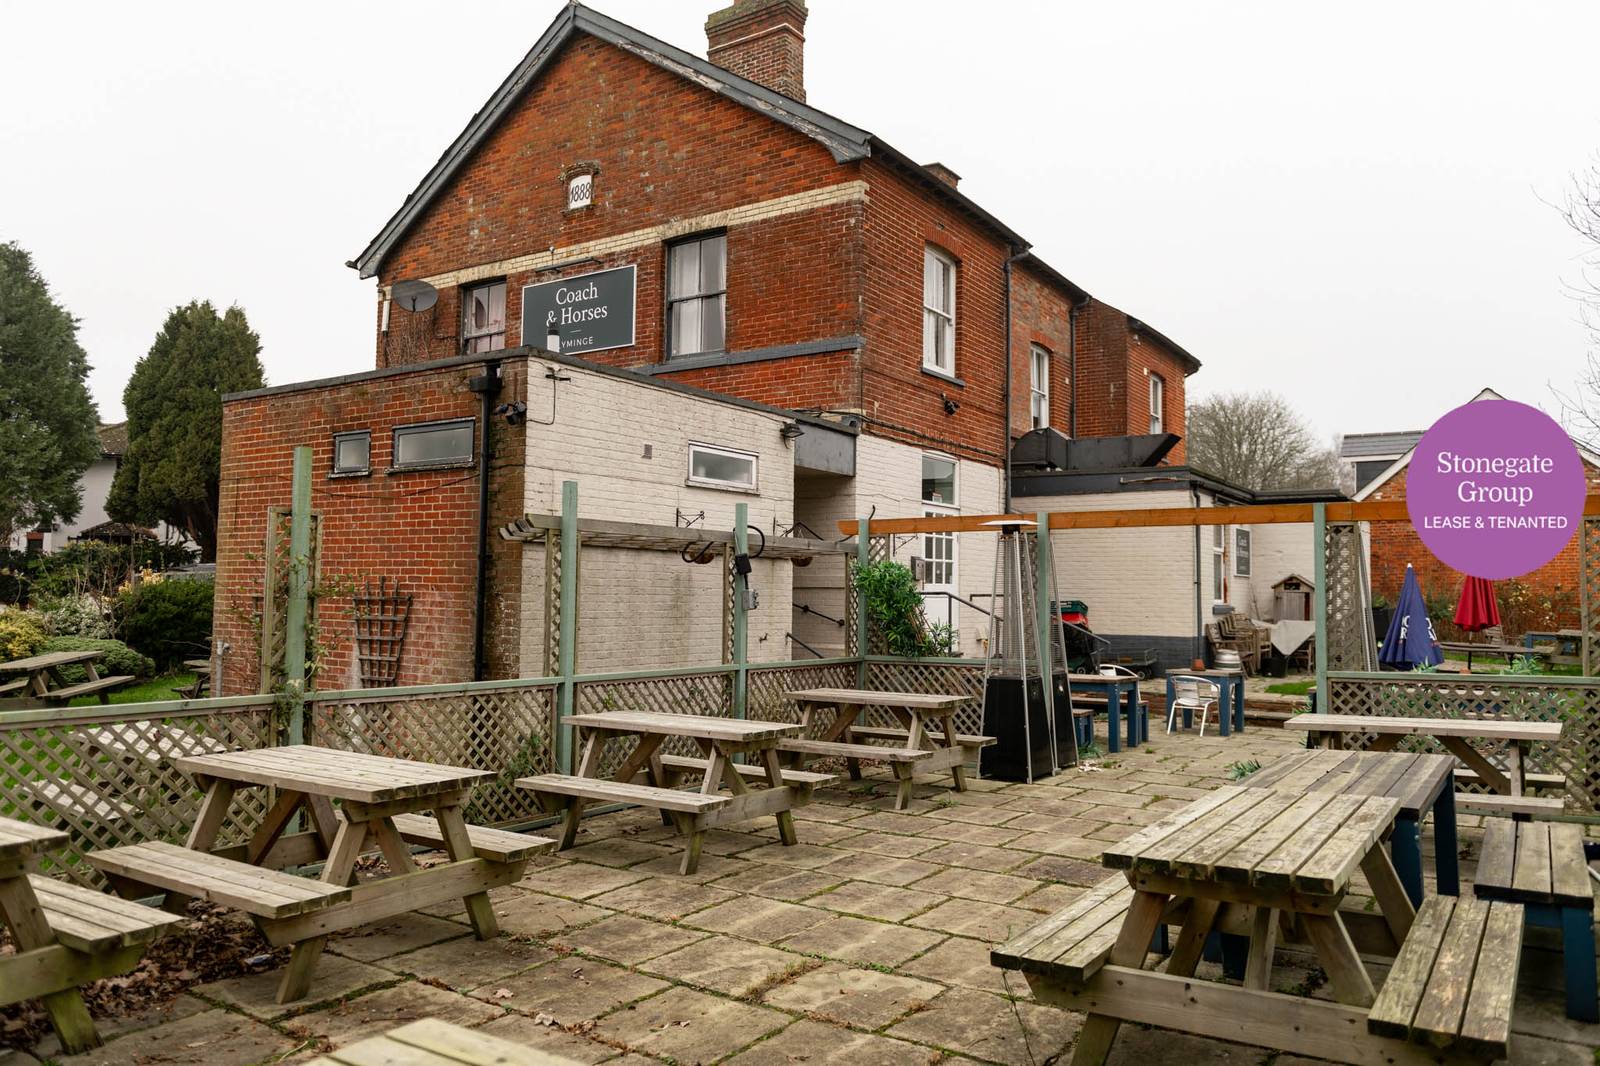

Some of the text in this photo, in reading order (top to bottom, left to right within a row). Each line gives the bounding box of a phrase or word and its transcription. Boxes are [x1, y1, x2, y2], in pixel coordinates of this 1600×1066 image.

[570, 182, 592, 203] 1888
[556, 282, 598, 305] Coach
[546, 305, 608, 326] & Horses
[559, 336, 594, 349] YMINGE
